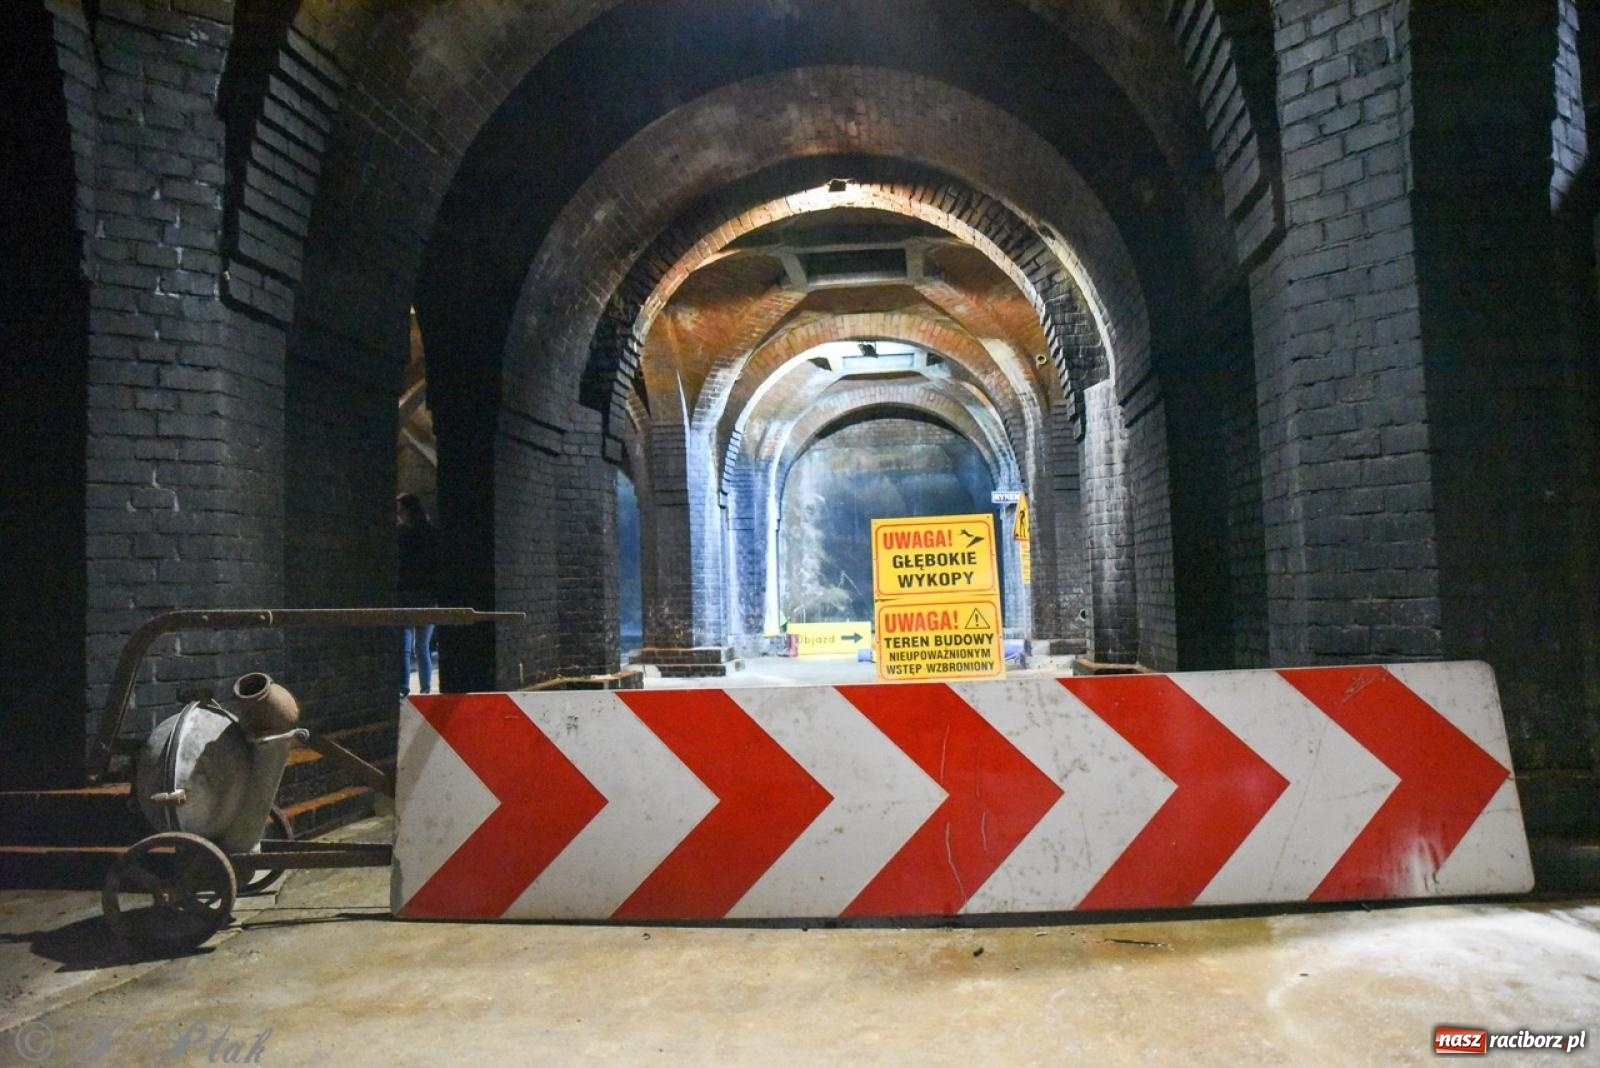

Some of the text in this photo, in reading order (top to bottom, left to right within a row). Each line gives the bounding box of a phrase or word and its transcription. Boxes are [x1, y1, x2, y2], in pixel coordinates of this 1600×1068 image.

[883, 529, 953, 550] UWAGA!
[892, 551, 977, 570] GŁĘBOKIE
[897, 571, 974, 588] WYKOPY
[884, 610, 959, 633] UWAGA!
[884, 633, 994, 649] TEREN BUDOWY
[889, 647, 991, 661] NIEUPOWAŻNIONYM
[886, 661, 994, 675] WSTĘP WZBRONIONY
